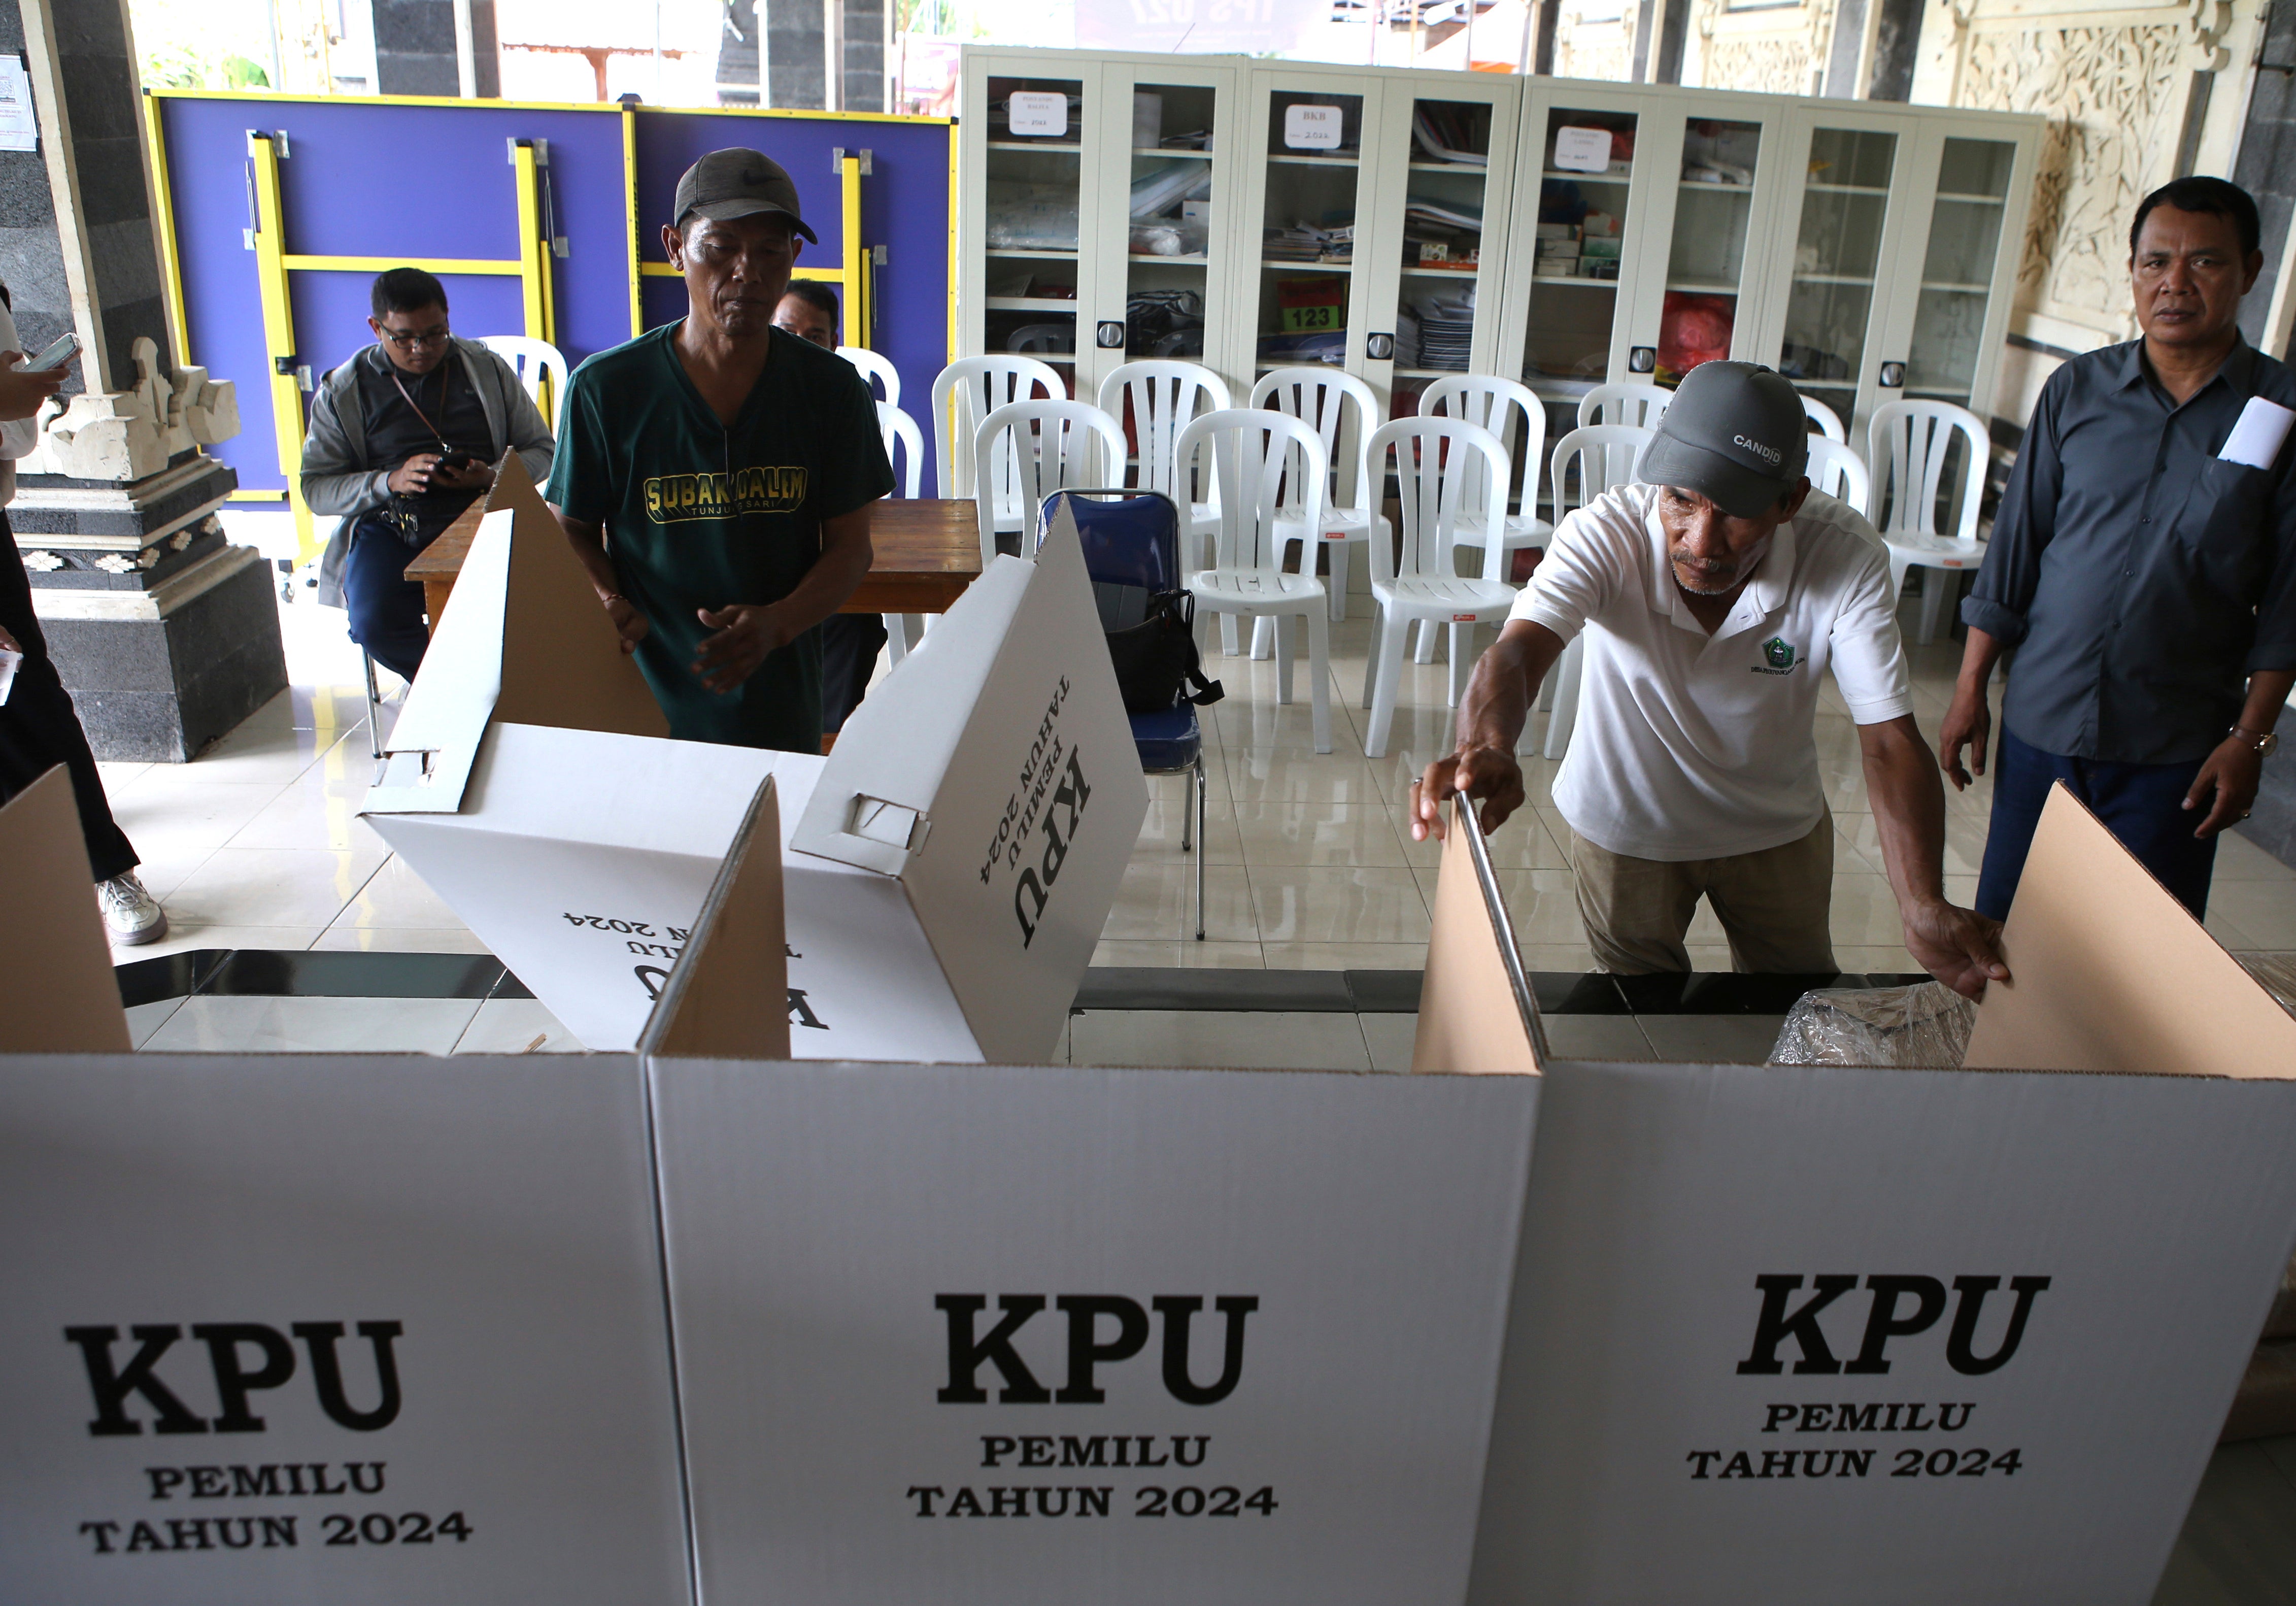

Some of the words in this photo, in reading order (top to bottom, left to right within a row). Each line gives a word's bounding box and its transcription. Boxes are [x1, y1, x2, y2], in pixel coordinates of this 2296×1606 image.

[1293, 307, 1330, 327] 123
[1733, 434, 1781, 463] CANDID
[646, 474, 731, 511] SUBAK
[746, 500, 775, 509] SARI
[1020, 674, 1070, 794] TAHUN
[1008, 734, 1063, 871] PEMILU
[980, 793, 1019, 886] 2024
[1015, 744, 1091, 951] KPU
[563, 913, 656, 937] 2024
[1736, 1273, 2053, 1377] KPU
[934, 1293, 1260, 1407] KPU
[61, 1320, 404, 1440] KPU
[1761, 1402, 1977, 1434] PEMILU
[980, 1435, 1211, 1468] PEMILU
[1685, 1448, 1878, 1481] TAHUN
[1889, 1447, 2024, 1479] 2024
[143, 1461, 387, 1501] PEMILU
[906, 1486, 1115, 1518] TAHUN
[1135, 1485, 1279, 1518] 2024
[78, 1516, 298, 1555] TAHUN
[321, 1511, 474, 1547] 2024
